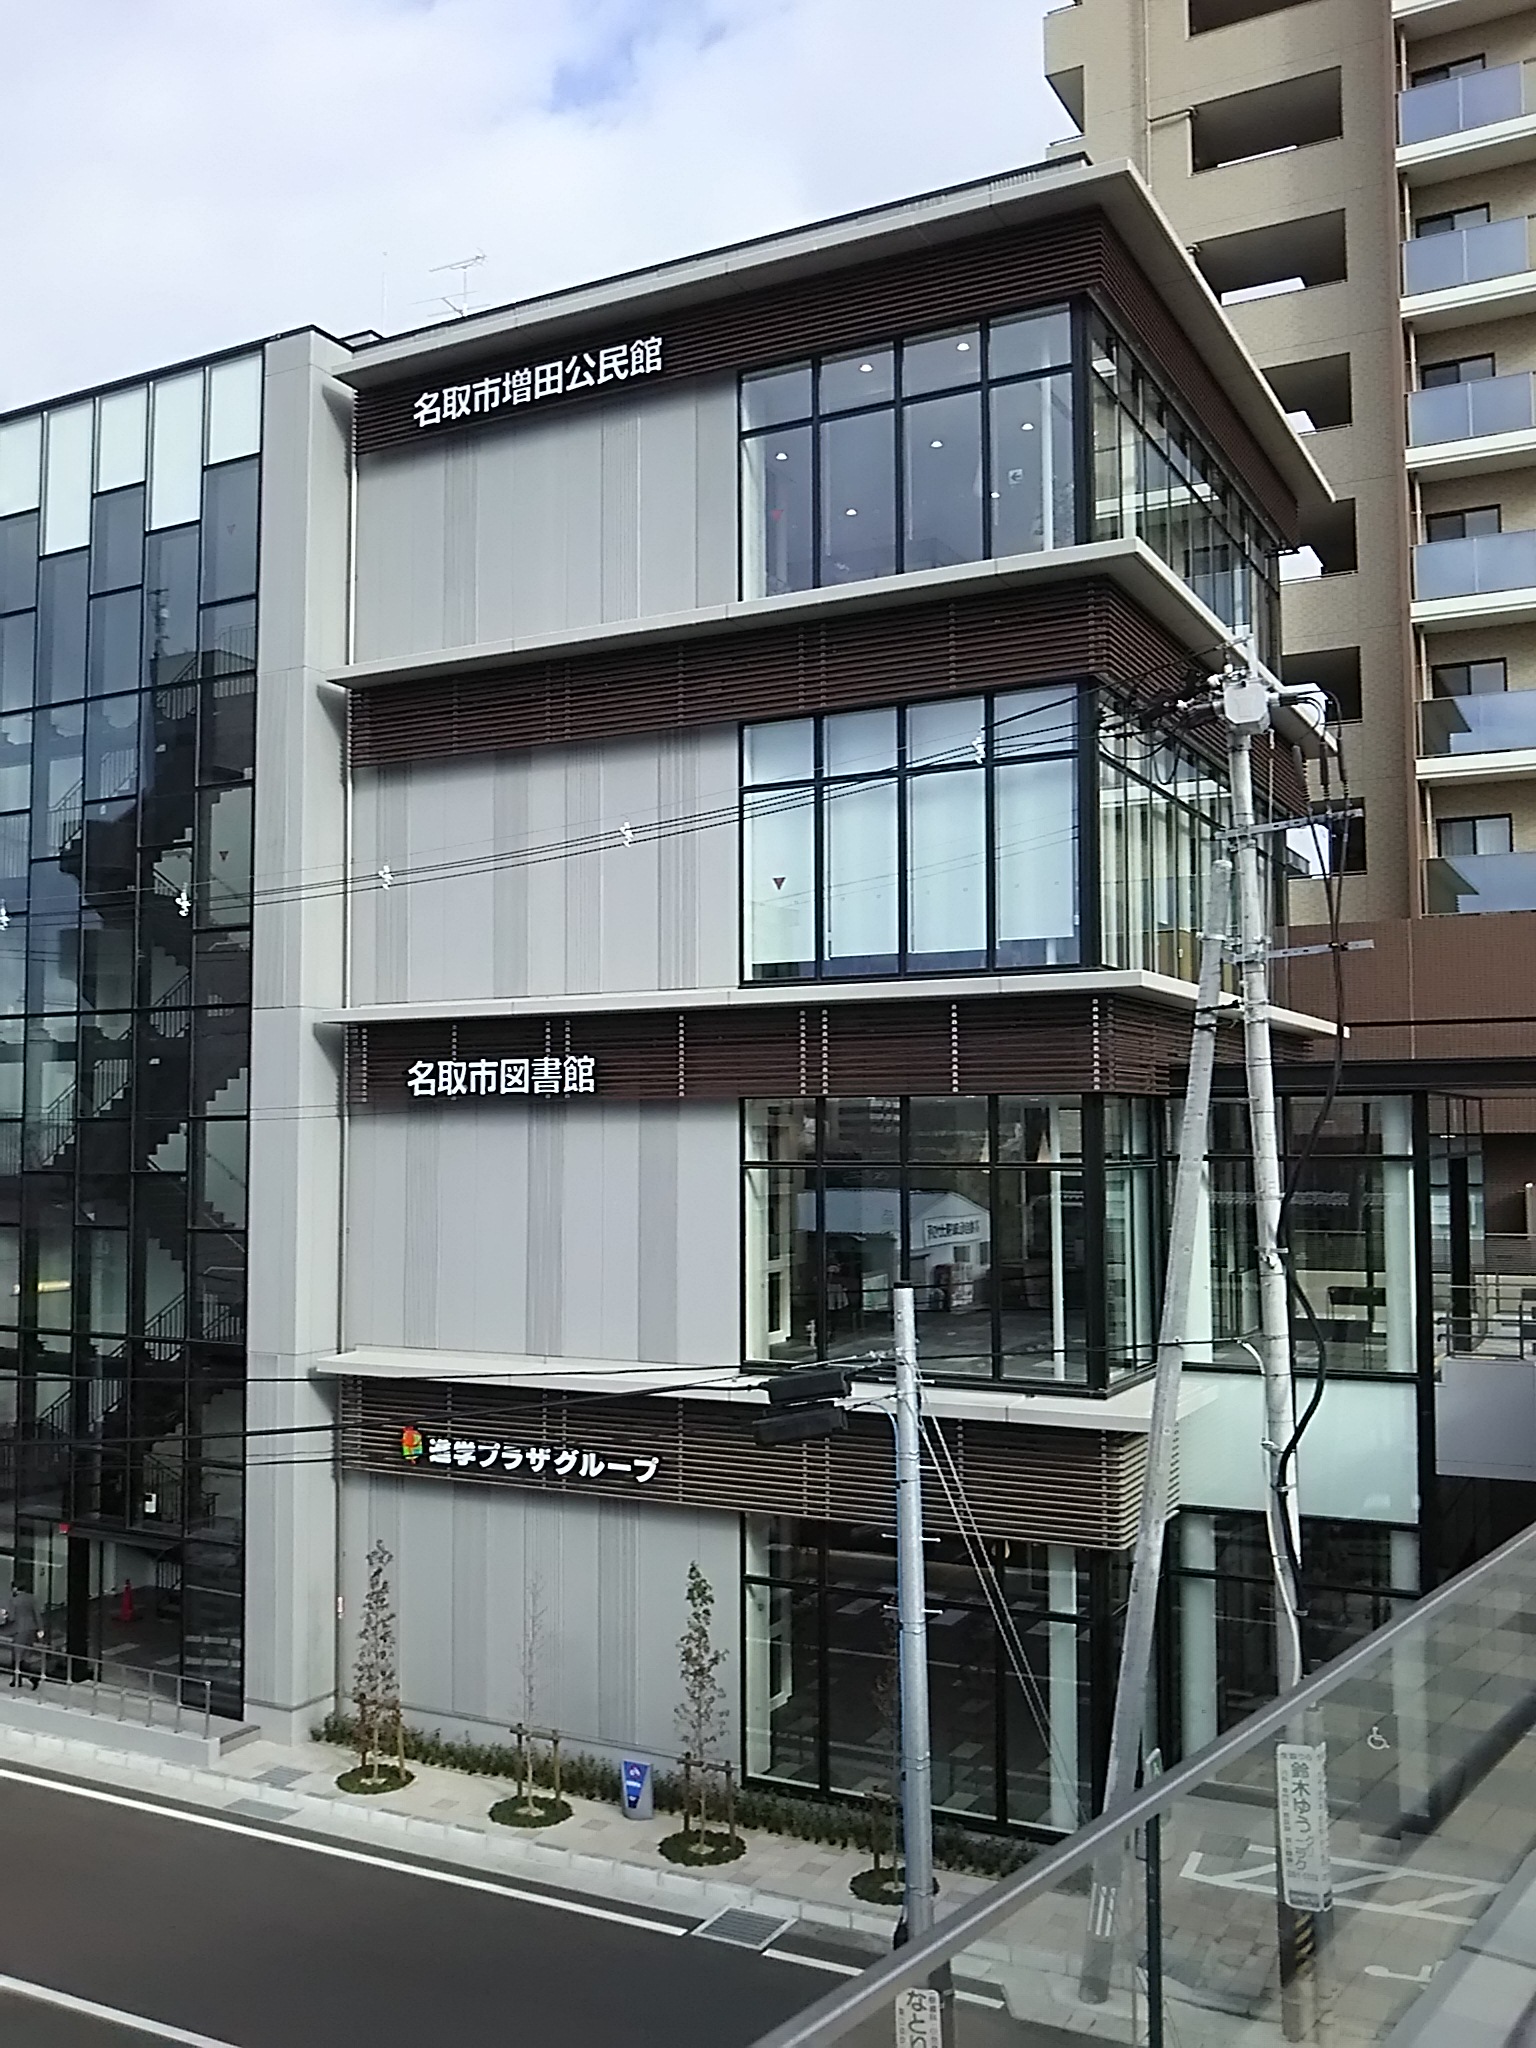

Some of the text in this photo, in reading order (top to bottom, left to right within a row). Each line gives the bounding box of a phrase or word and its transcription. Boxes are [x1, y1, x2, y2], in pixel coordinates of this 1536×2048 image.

[413, 336, 663, 428] 名取市増田公民館
[407, 1054, 596, 1097] 名取市図書館
[428, 1437, 660, 1484] 進学プラザグループ
